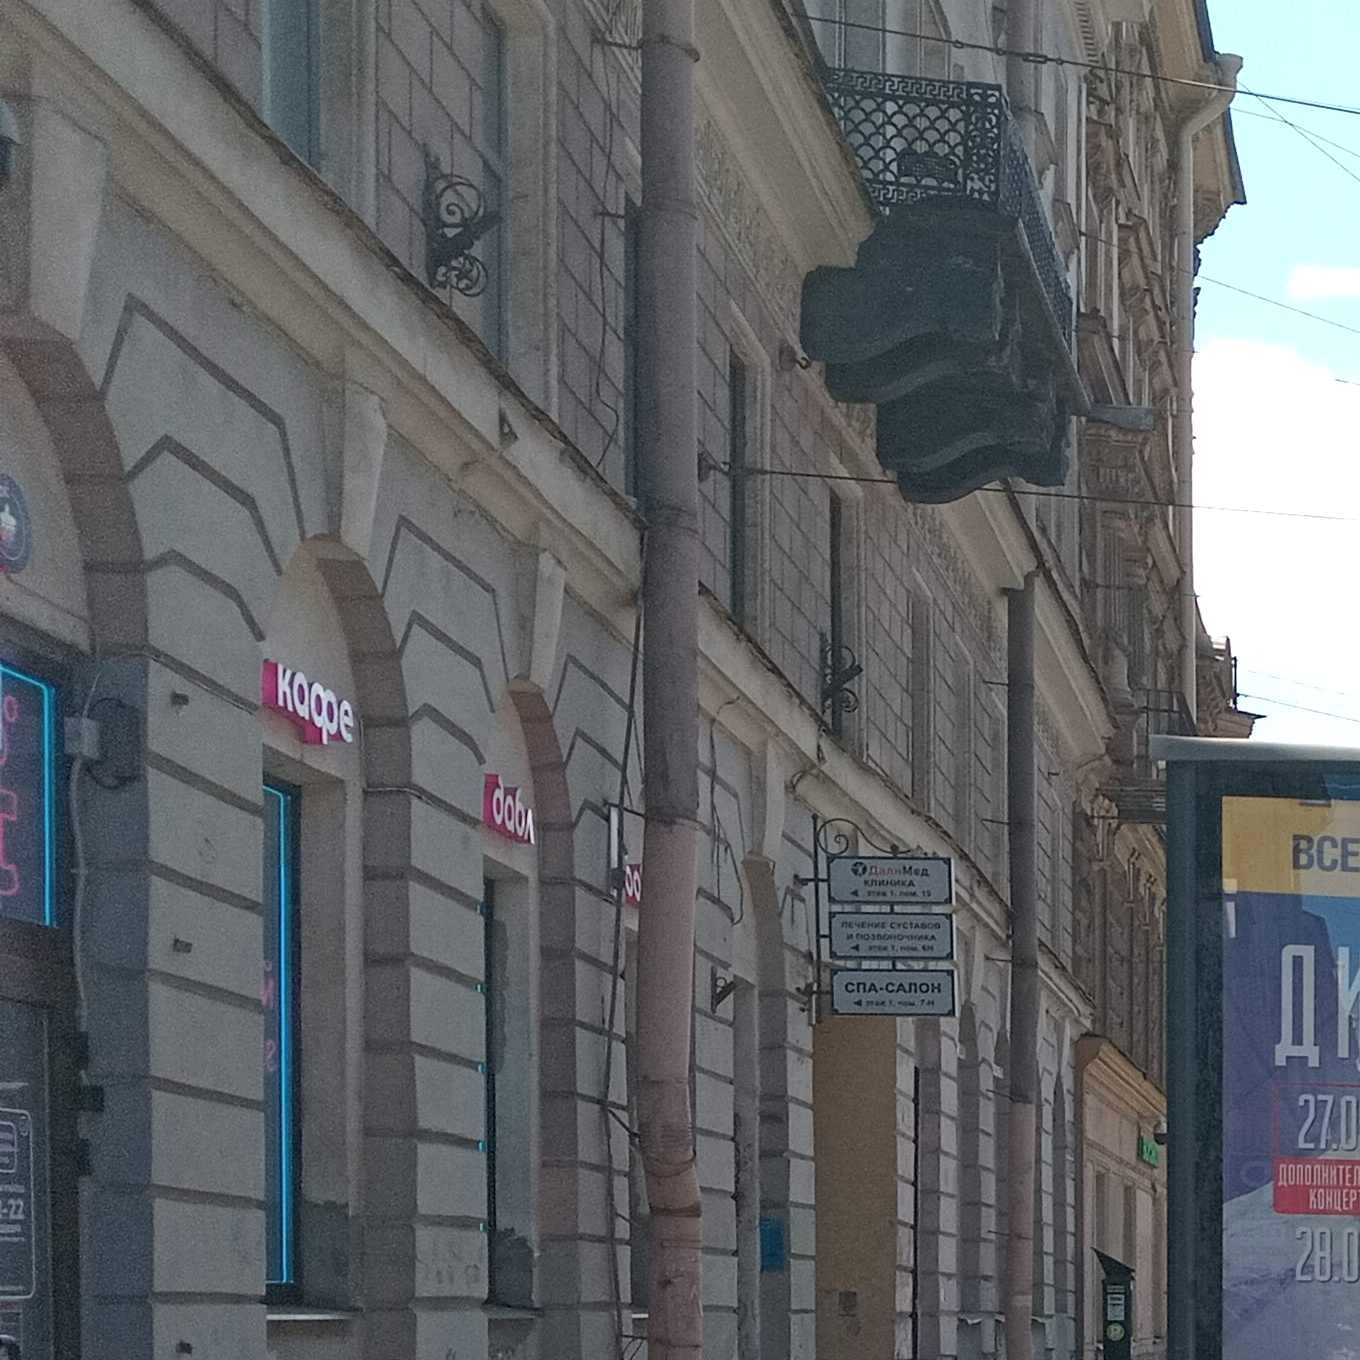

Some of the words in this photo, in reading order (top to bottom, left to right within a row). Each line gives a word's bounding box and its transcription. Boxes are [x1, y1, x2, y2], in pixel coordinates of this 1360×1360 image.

[277, 663, 354, 745] кафе
[1291, 834, 1360, 873] ВСЕ
[844, 981, 942, 994] СПА-САЛОН
